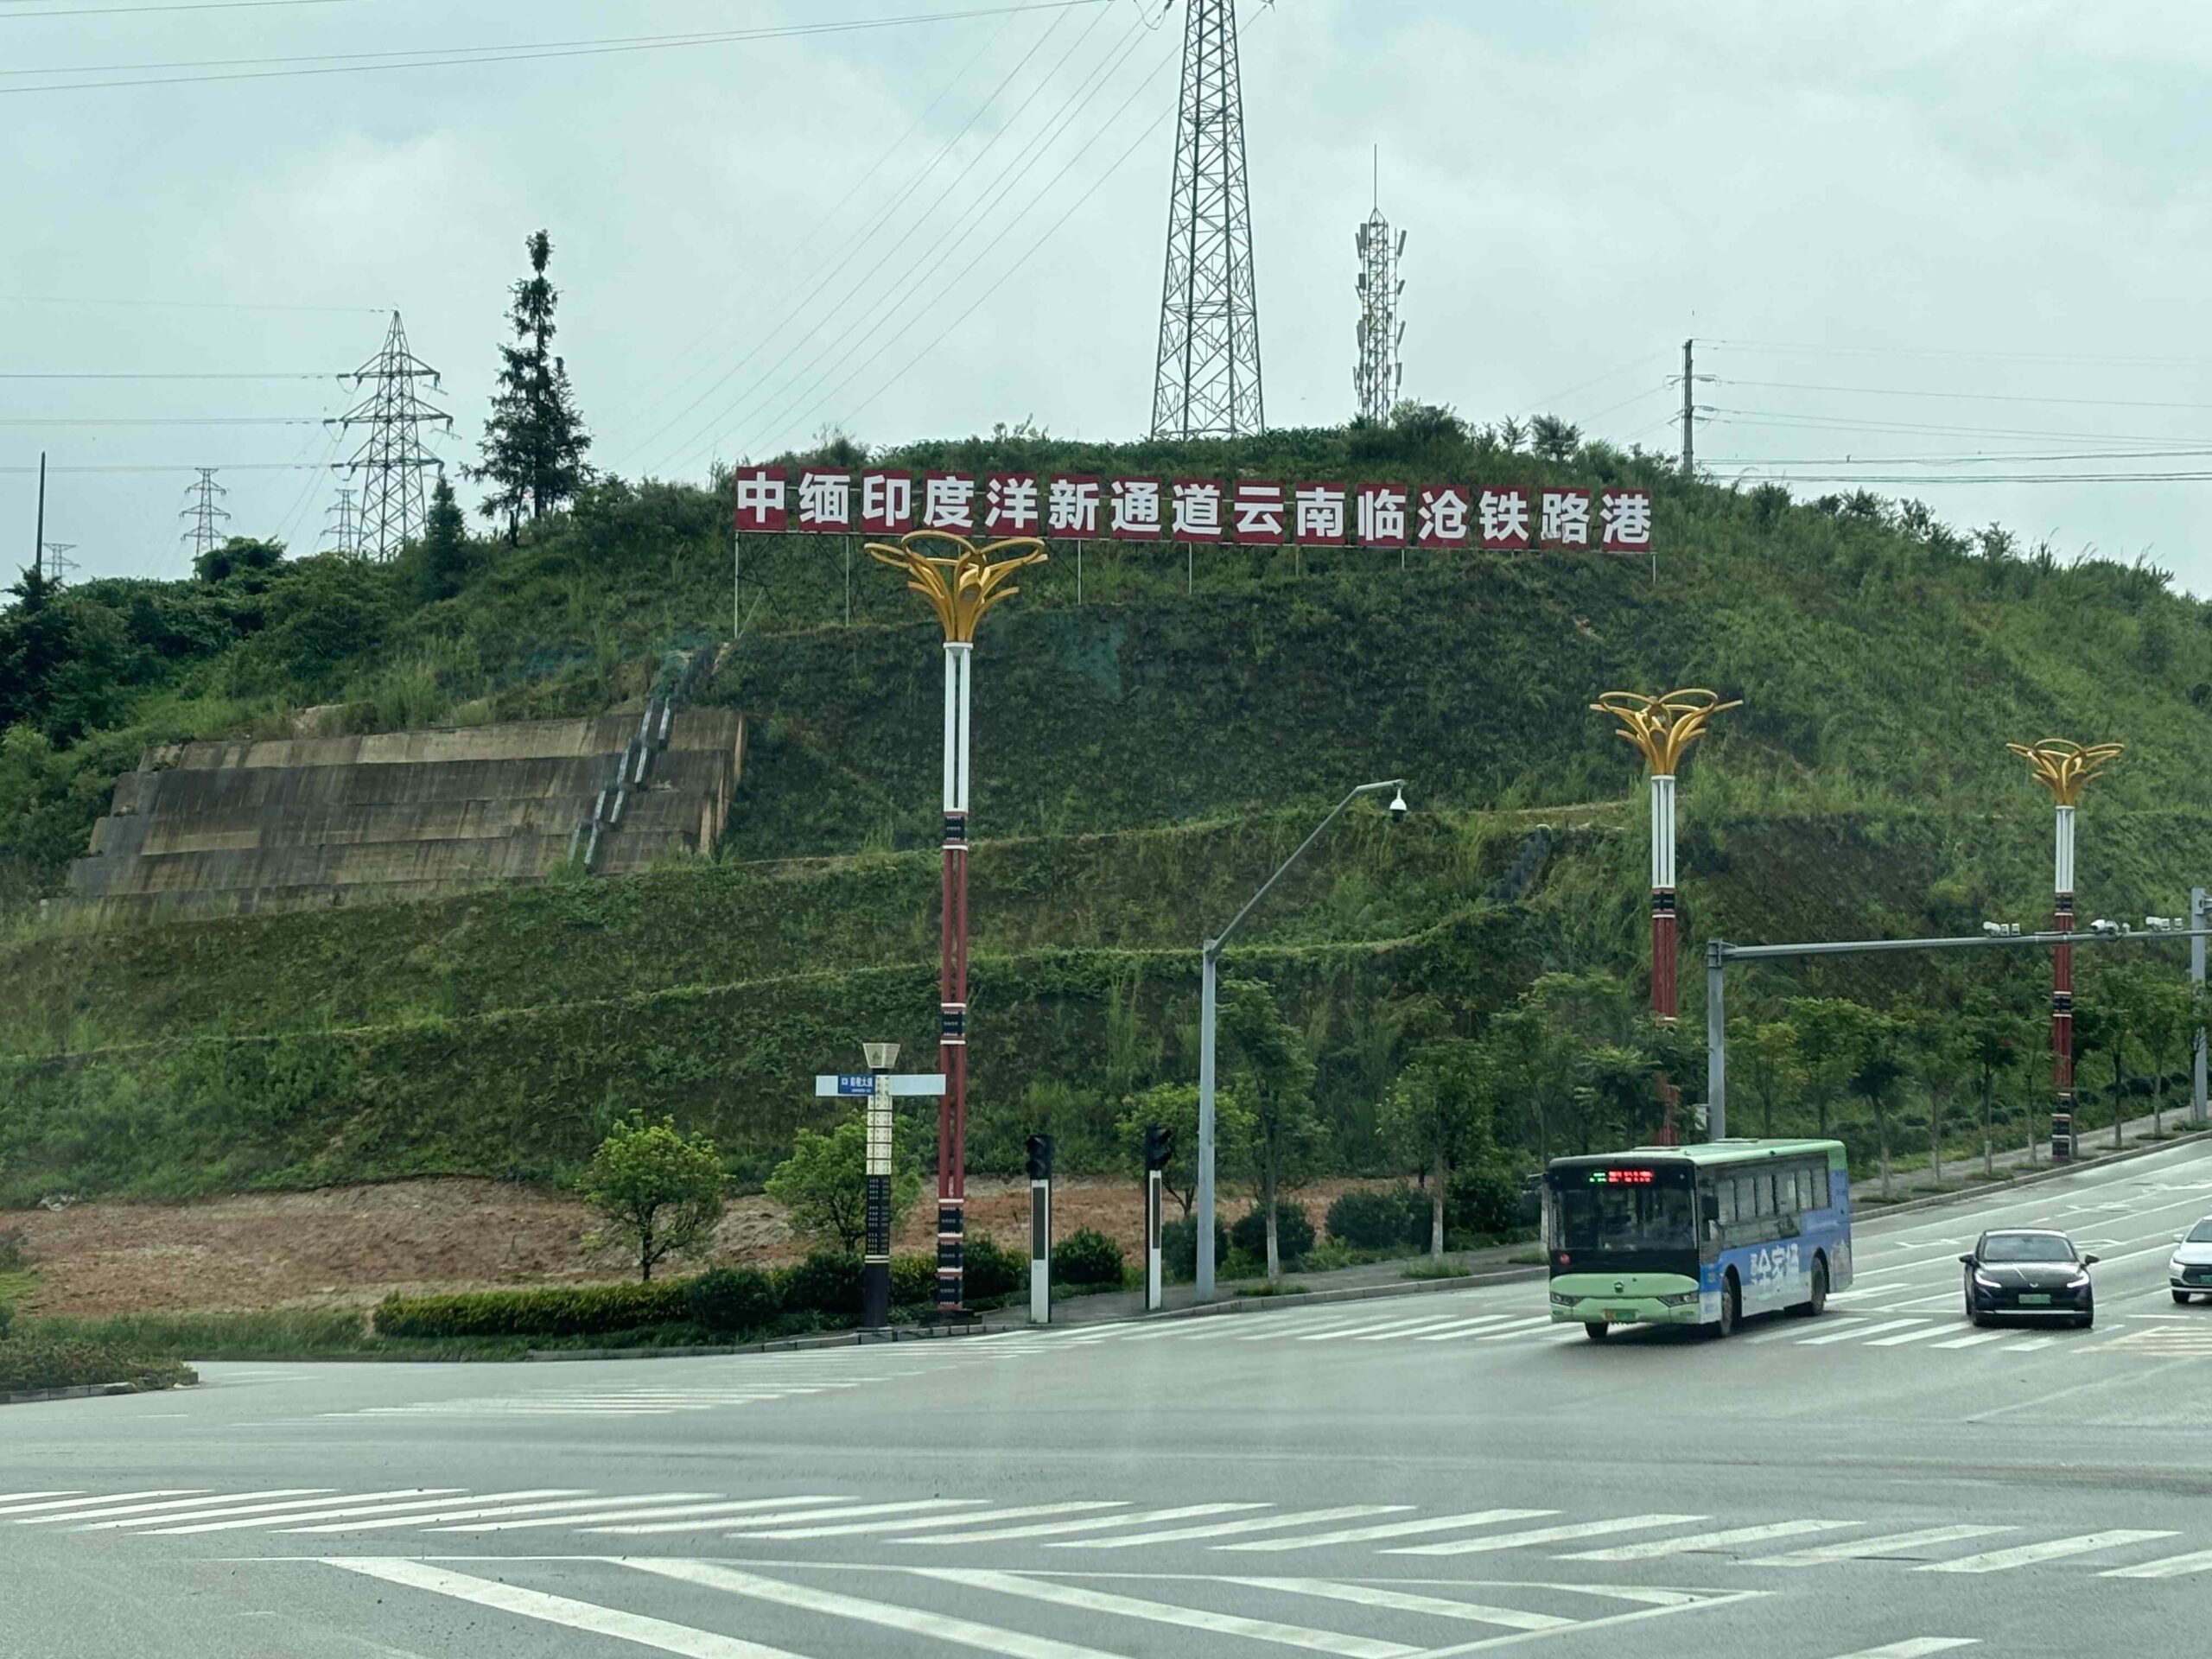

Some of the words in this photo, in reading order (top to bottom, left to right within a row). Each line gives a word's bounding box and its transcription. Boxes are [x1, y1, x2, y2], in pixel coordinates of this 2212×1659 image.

[736, 471, 1651, 544] 中缅印度洋新通道云南临沧铁路港
